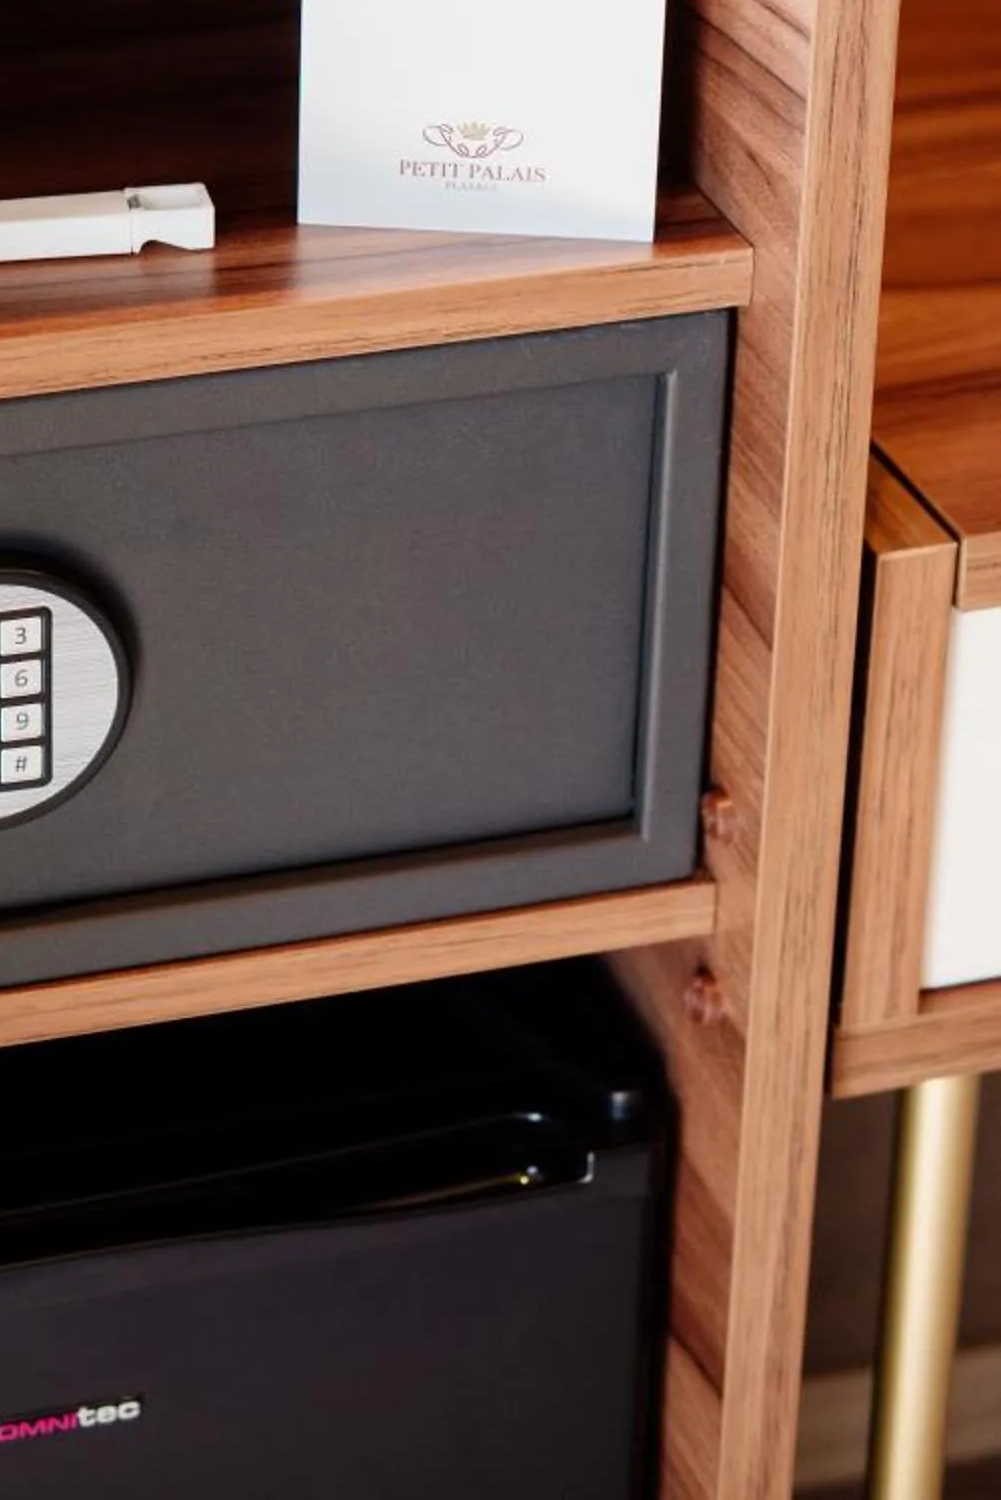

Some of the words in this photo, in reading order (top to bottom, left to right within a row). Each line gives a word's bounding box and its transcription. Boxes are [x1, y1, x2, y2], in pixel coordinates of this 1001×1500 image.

[399, 158, 464, 179] PETIT
[468, 162, 548, 184] PALAIS
[14, 627, 27, 645] 3
[14, 669, 28, 687] 6
[15, 712, 29, 730] 9
[14, 756, 27, 773] #
